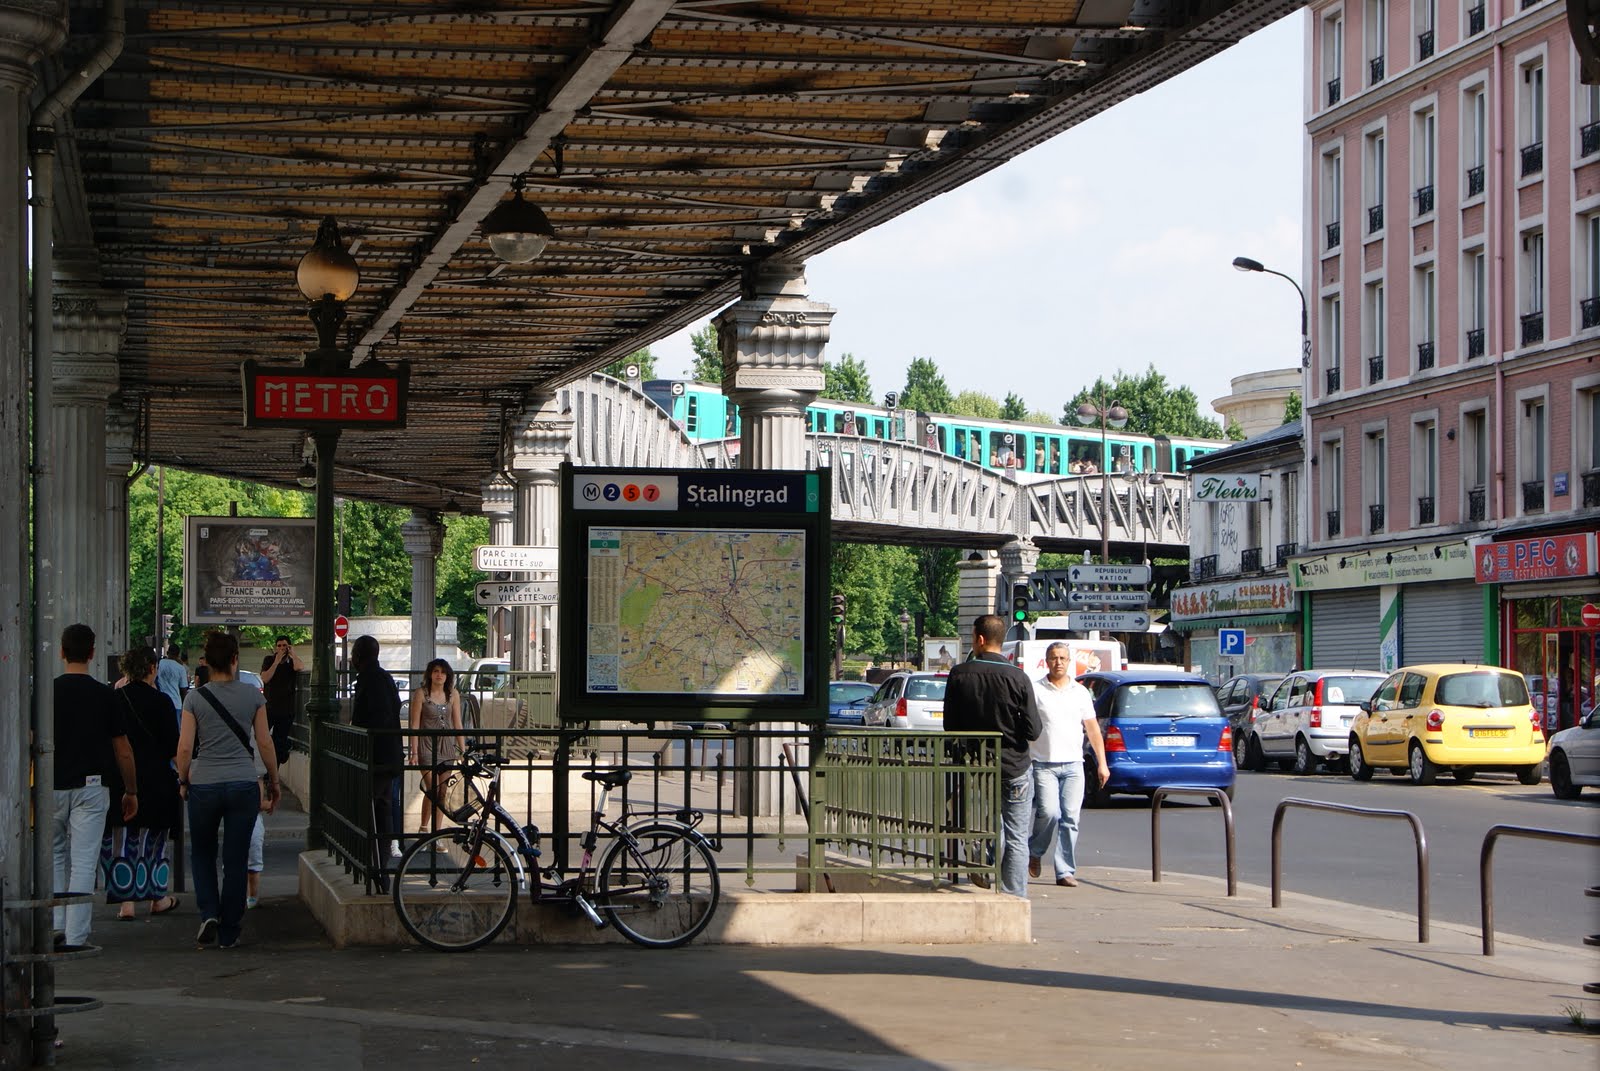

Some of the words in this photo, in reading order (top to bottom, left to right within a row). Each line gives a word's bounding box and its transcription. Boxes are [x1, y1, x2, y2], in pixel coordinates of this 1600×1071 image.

[264, 382, 389, 414] METRO
[687, 484, 788, 507] Stalingrad
[1196, 477, 1257, 499] Fleurs
[1514, 539, 1557, 569] P.F.C
[1304, 564, 1330, 577] OLPAN
[1514, 566, 1558, 580] RESTAURANT
[225, 587, 254, 595] FRANCE
[261, 587, 291, 595] CANADA
[250, 597, 281, 605] DIMANCHE
[1226, 634, 1239, 651] P
